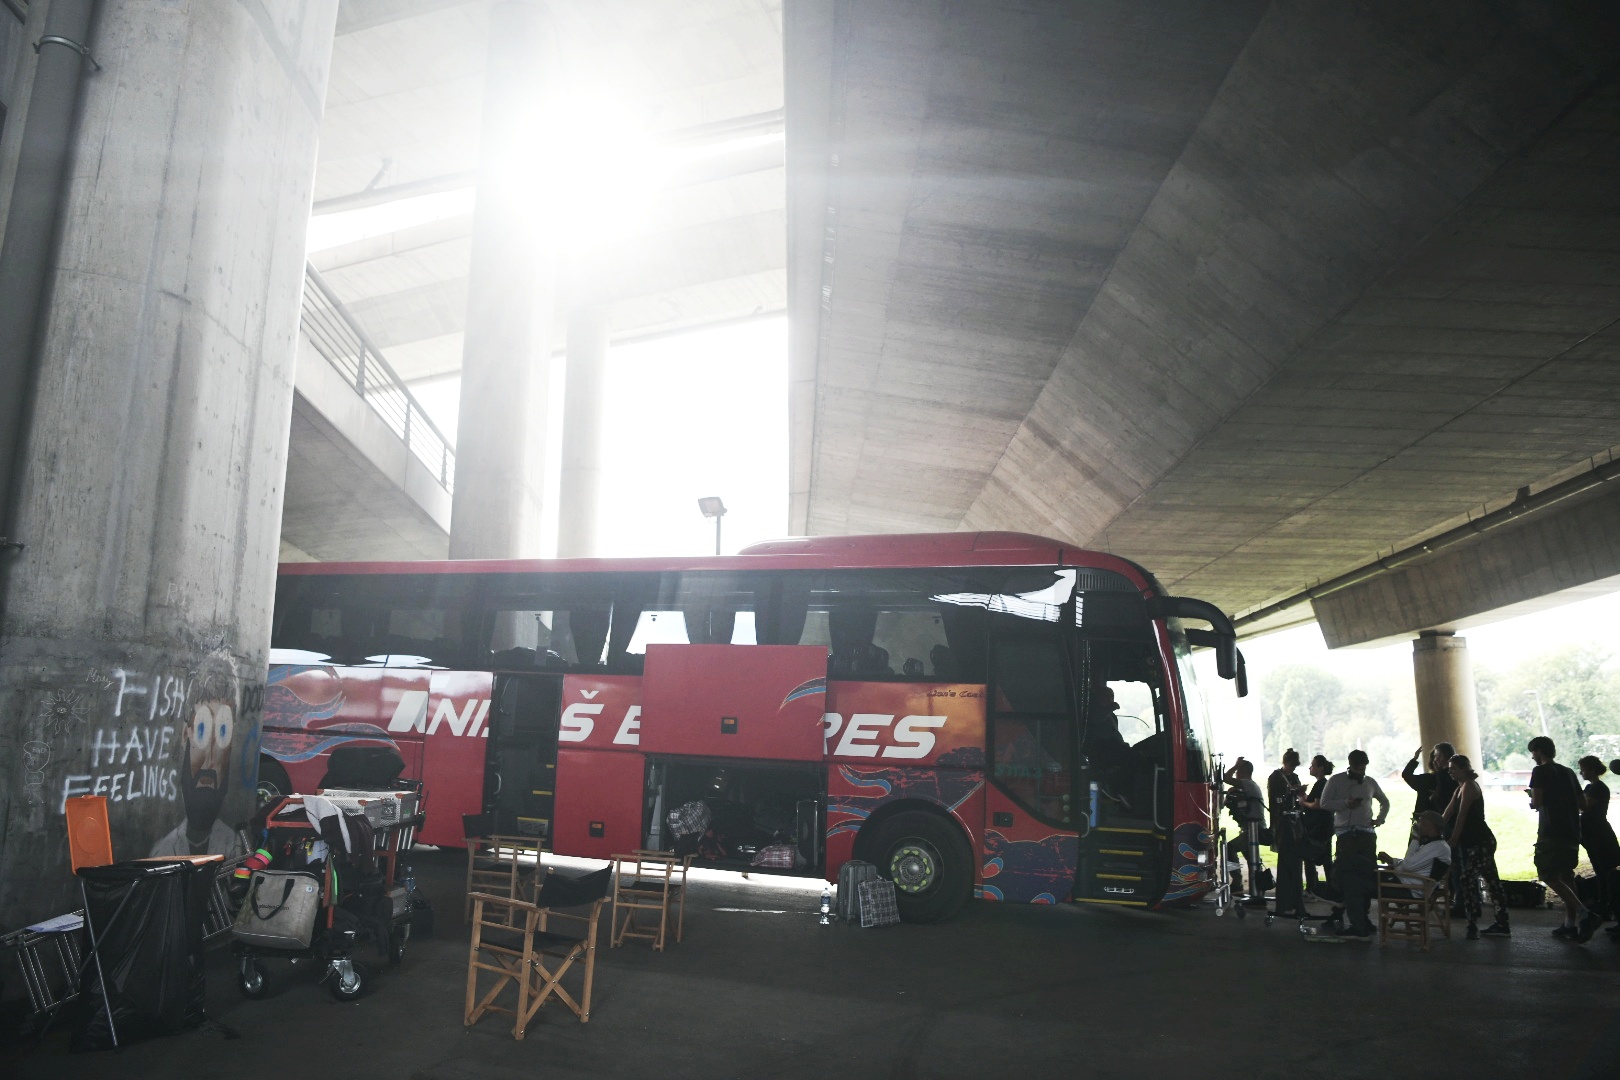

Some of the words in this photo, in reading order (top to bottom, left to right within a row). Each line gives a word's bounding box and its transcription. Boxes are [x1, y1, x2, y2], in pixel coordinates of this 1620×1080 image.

[113, 667, 185, 720] FISH
[93, 726, 174, 768] HAVE
[61, 765, 177, 815] FEELINGS
